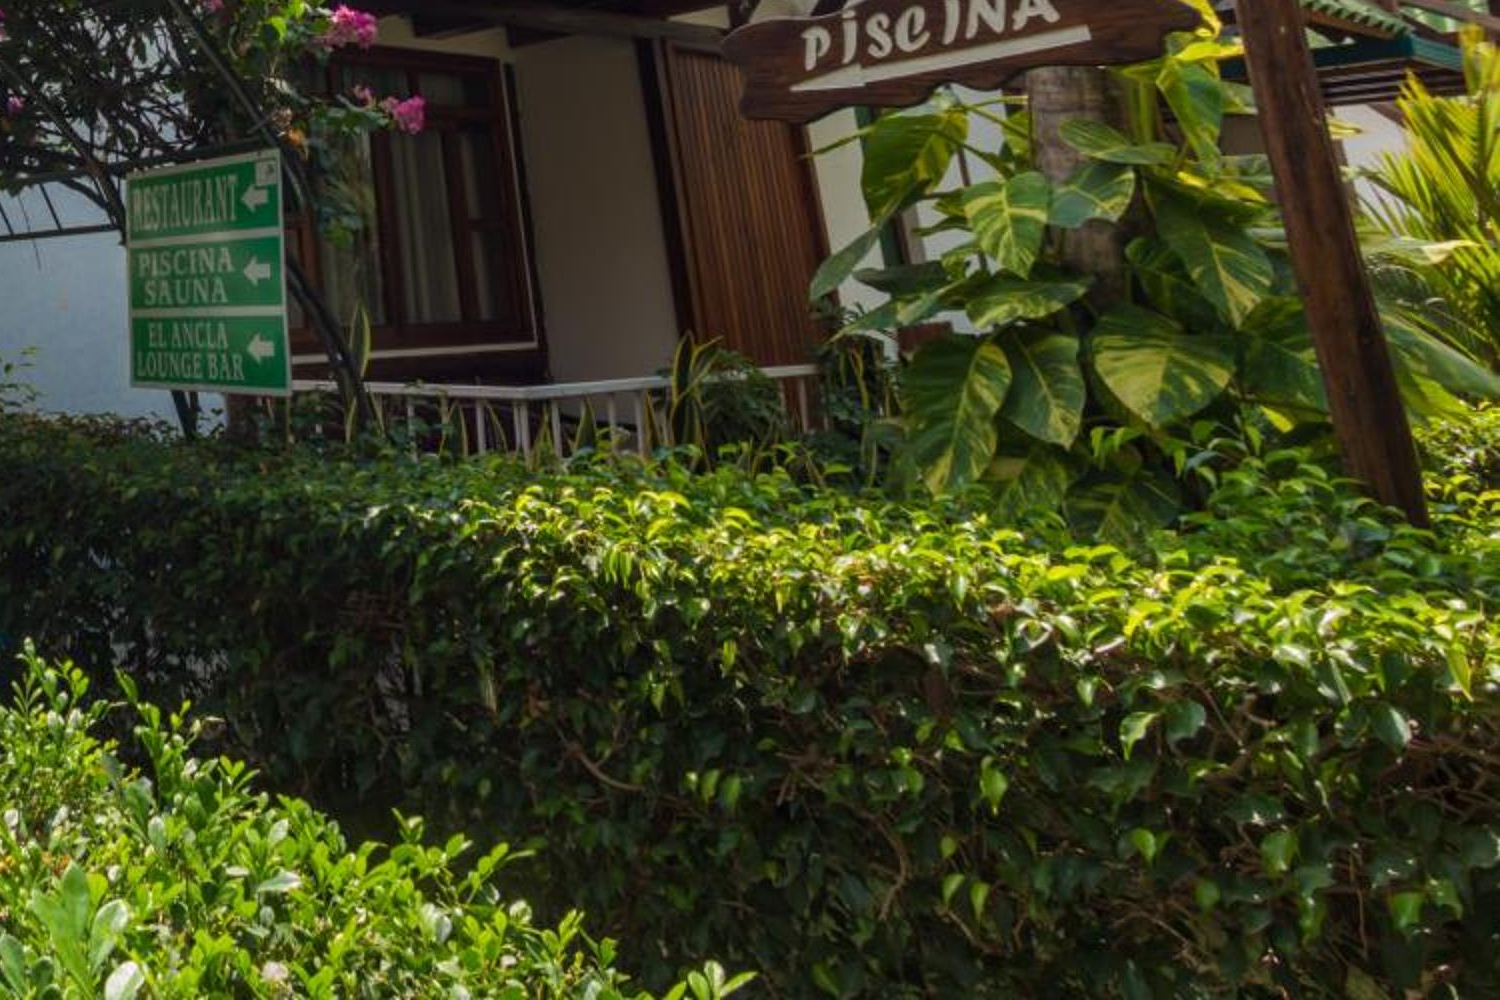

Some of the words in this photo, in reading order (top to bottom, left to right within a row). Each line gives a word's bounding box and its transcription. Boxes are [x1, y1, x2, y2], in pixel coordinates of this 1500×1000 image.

[132, 174, 238, 232] RESTAURANT
[138, 248, 234, 277] PISCINA
[144, 277, 228, 304] SAUNA
[149, 323, 165, 348] EL
[170, 323, 228, 350] ANCLA
[136, 354, 203, 379] LOUNGE
[208, 353, 245, 381] BAR
